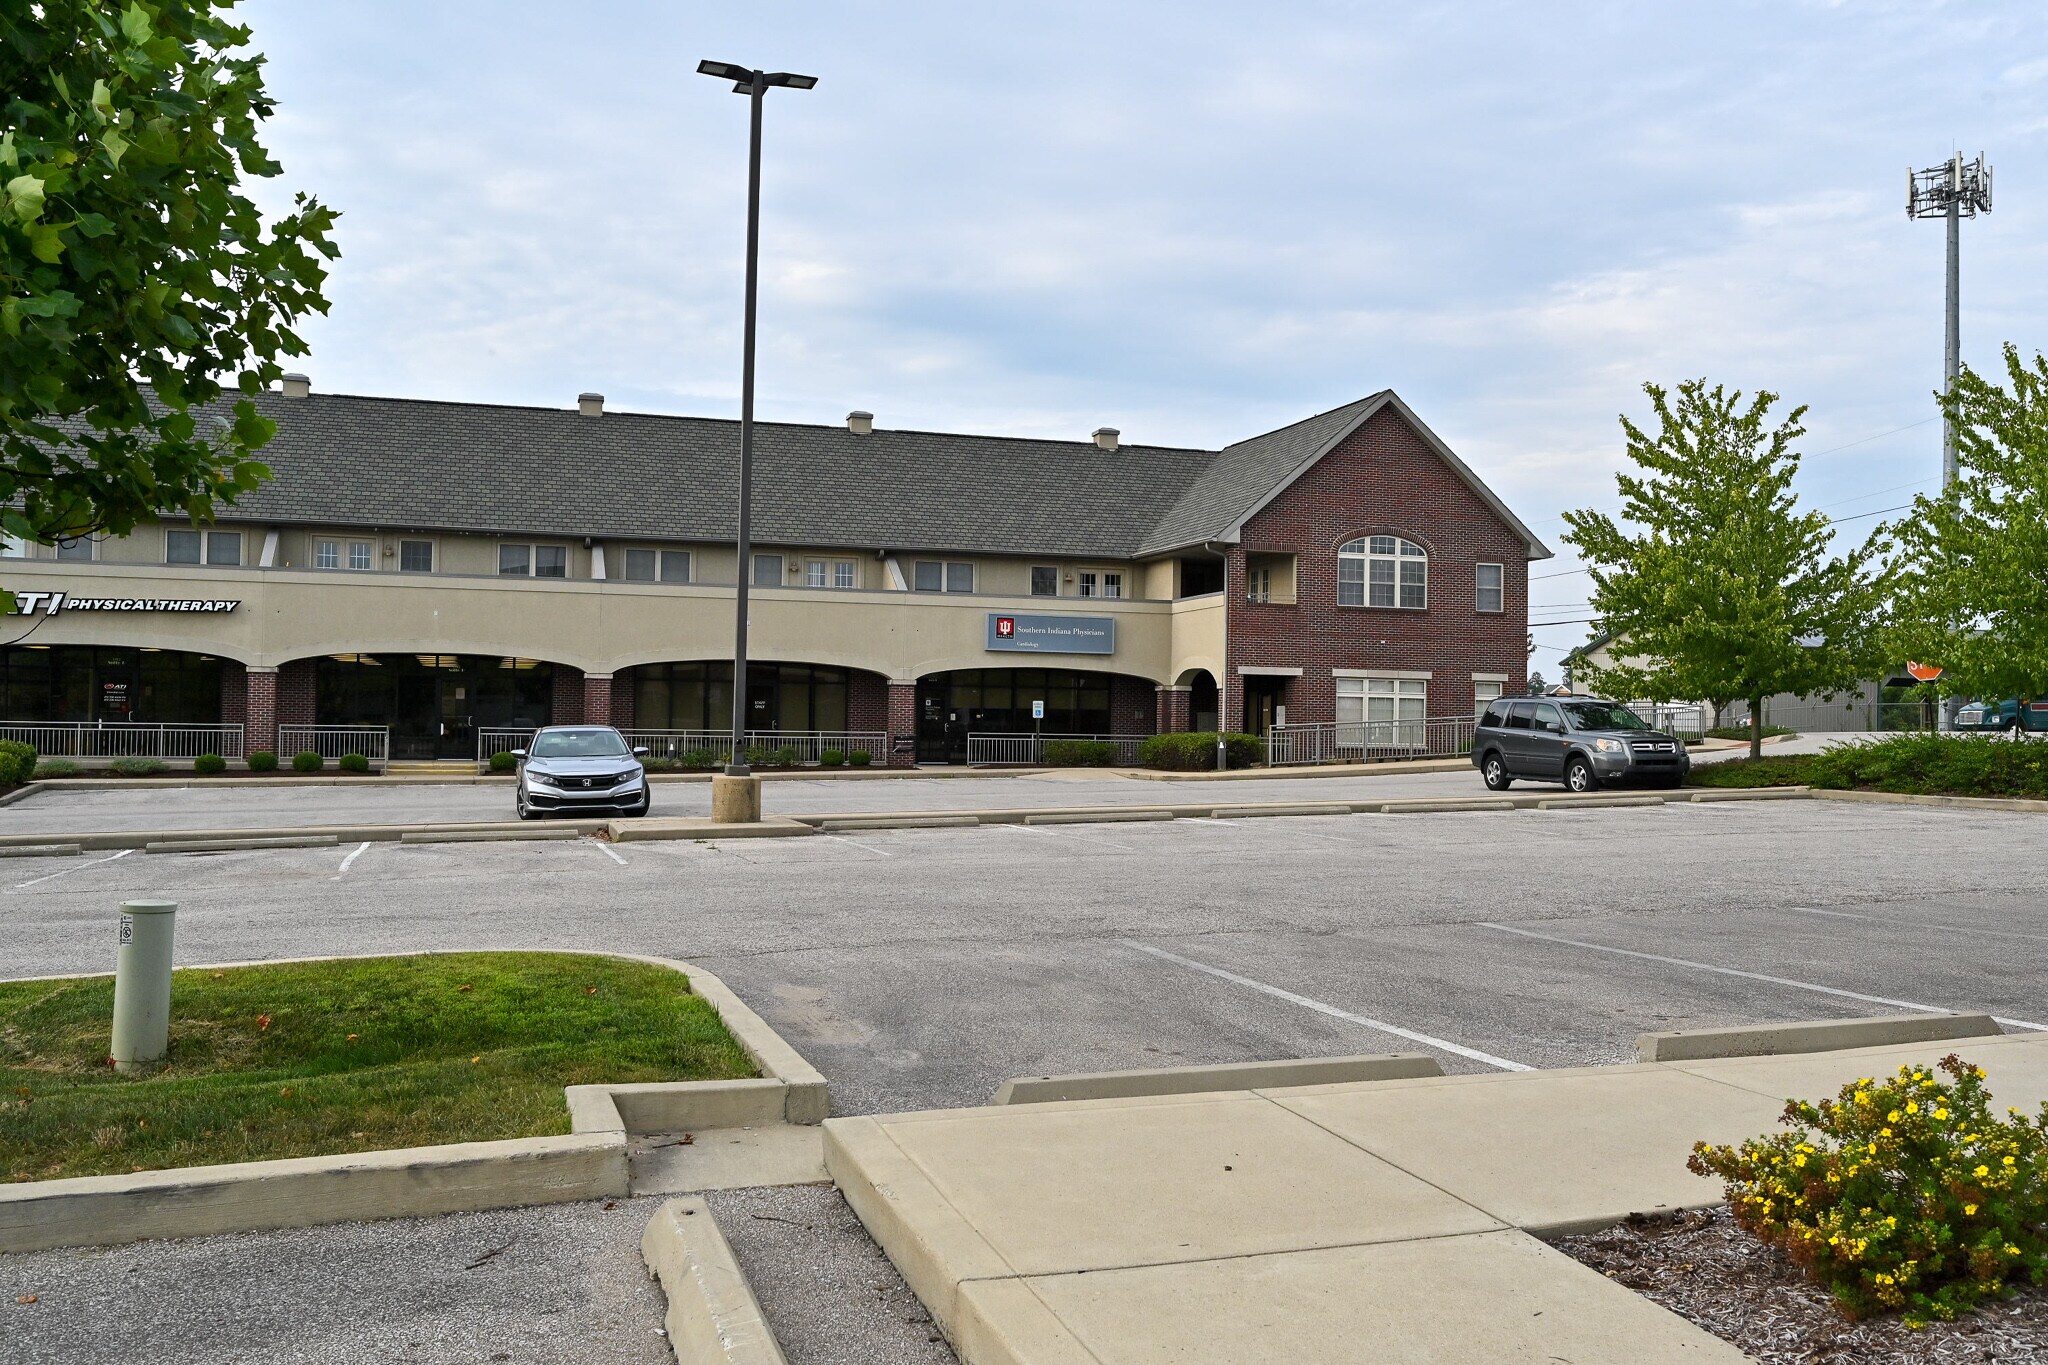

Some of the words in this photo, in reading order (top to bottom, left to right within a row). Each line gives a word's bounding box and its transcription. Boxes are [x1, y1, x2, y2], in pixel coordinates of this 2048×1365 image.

[2, 592, 65, 615] TI
[67, 599, 156, 611] PHYSICAL
[158, 600, 238, 612] THERAPY
[1017, 625, 1046, 634] Southern
[1047, 627, 1071, 635] Indiana
[1073, 628, 1105, 637] Physicians
